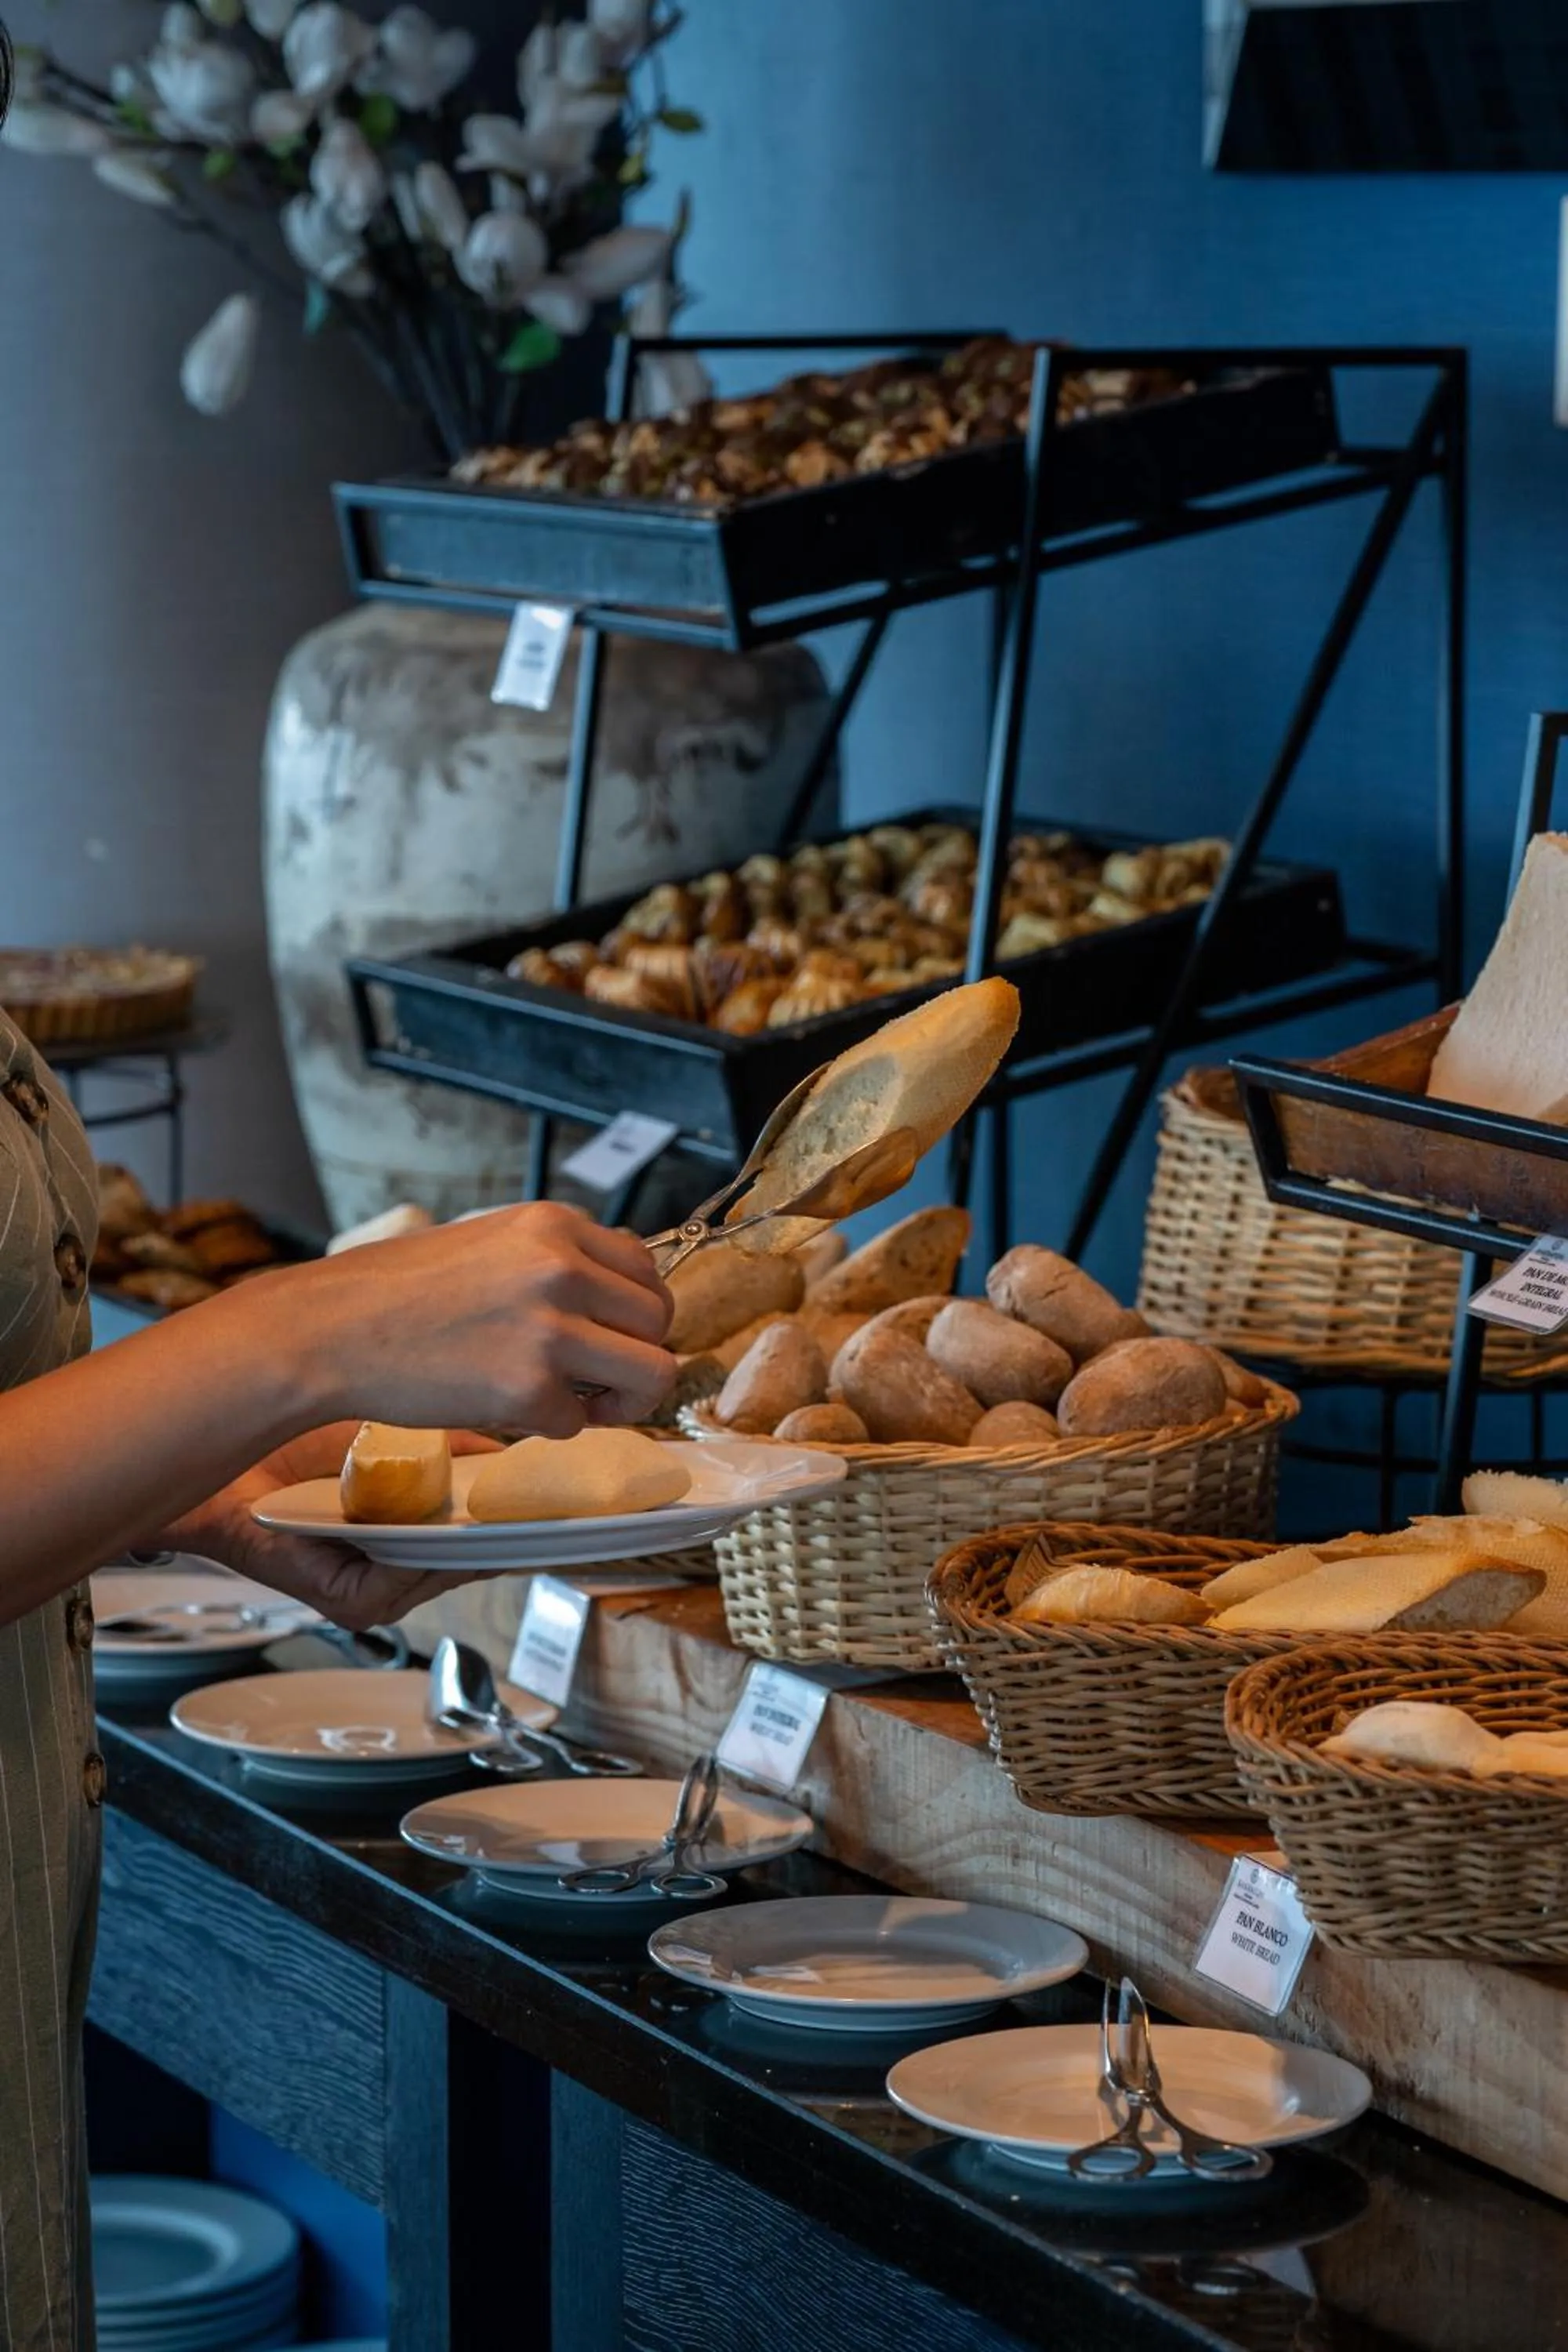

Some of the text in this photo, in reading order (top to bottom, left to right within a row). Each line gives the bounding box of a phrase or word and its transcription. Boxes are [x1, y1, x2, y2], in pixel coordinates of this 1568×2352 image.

[1236, 1911, 1288, 1947] PAN BLANCO
[1231, 1932, 1280, 1965] WHITE BREAD
